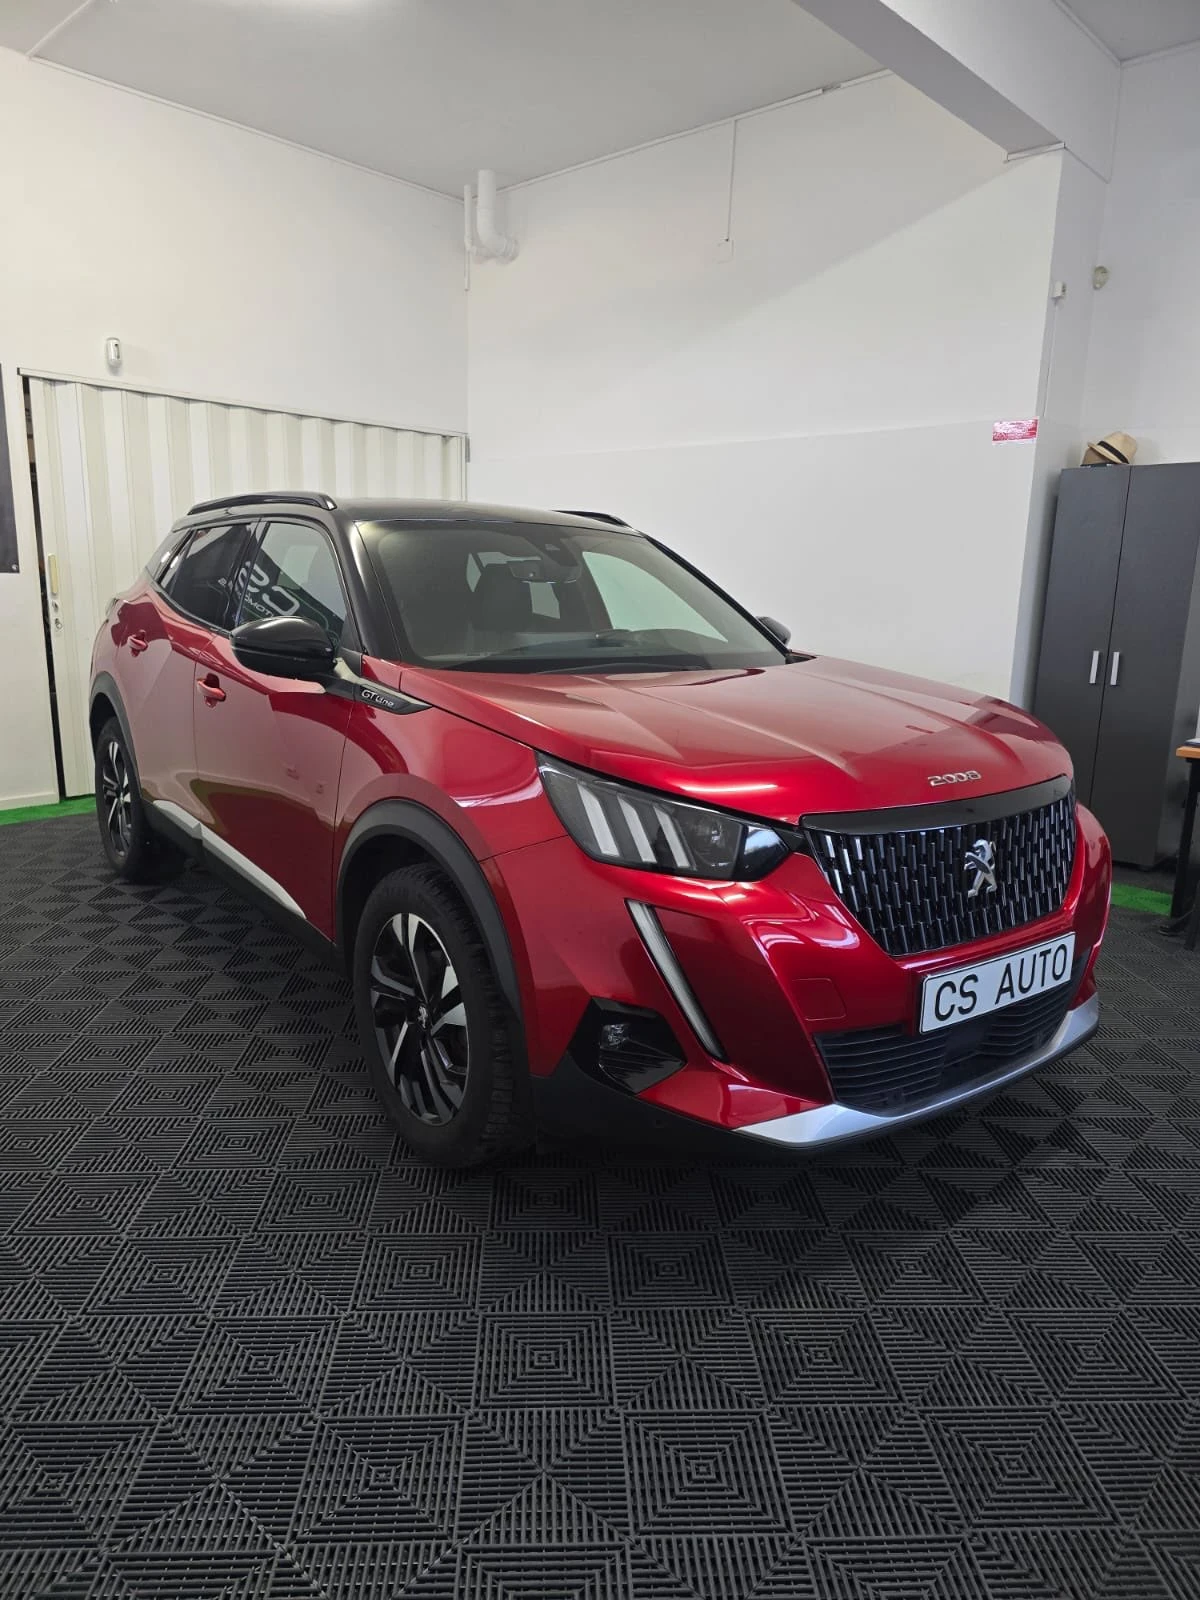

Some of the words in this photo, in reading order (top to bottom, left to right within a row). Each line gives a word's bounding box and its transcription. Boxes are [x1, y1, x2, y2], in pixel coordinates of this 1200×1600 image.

[361, 689, 377, 699] GT
[375, 695, 395, 708] Line
[927, 770, 982, 787] 2008
[934, 973, 979, 1021] CS
[995, 943, 1068, 1005] AUTO
